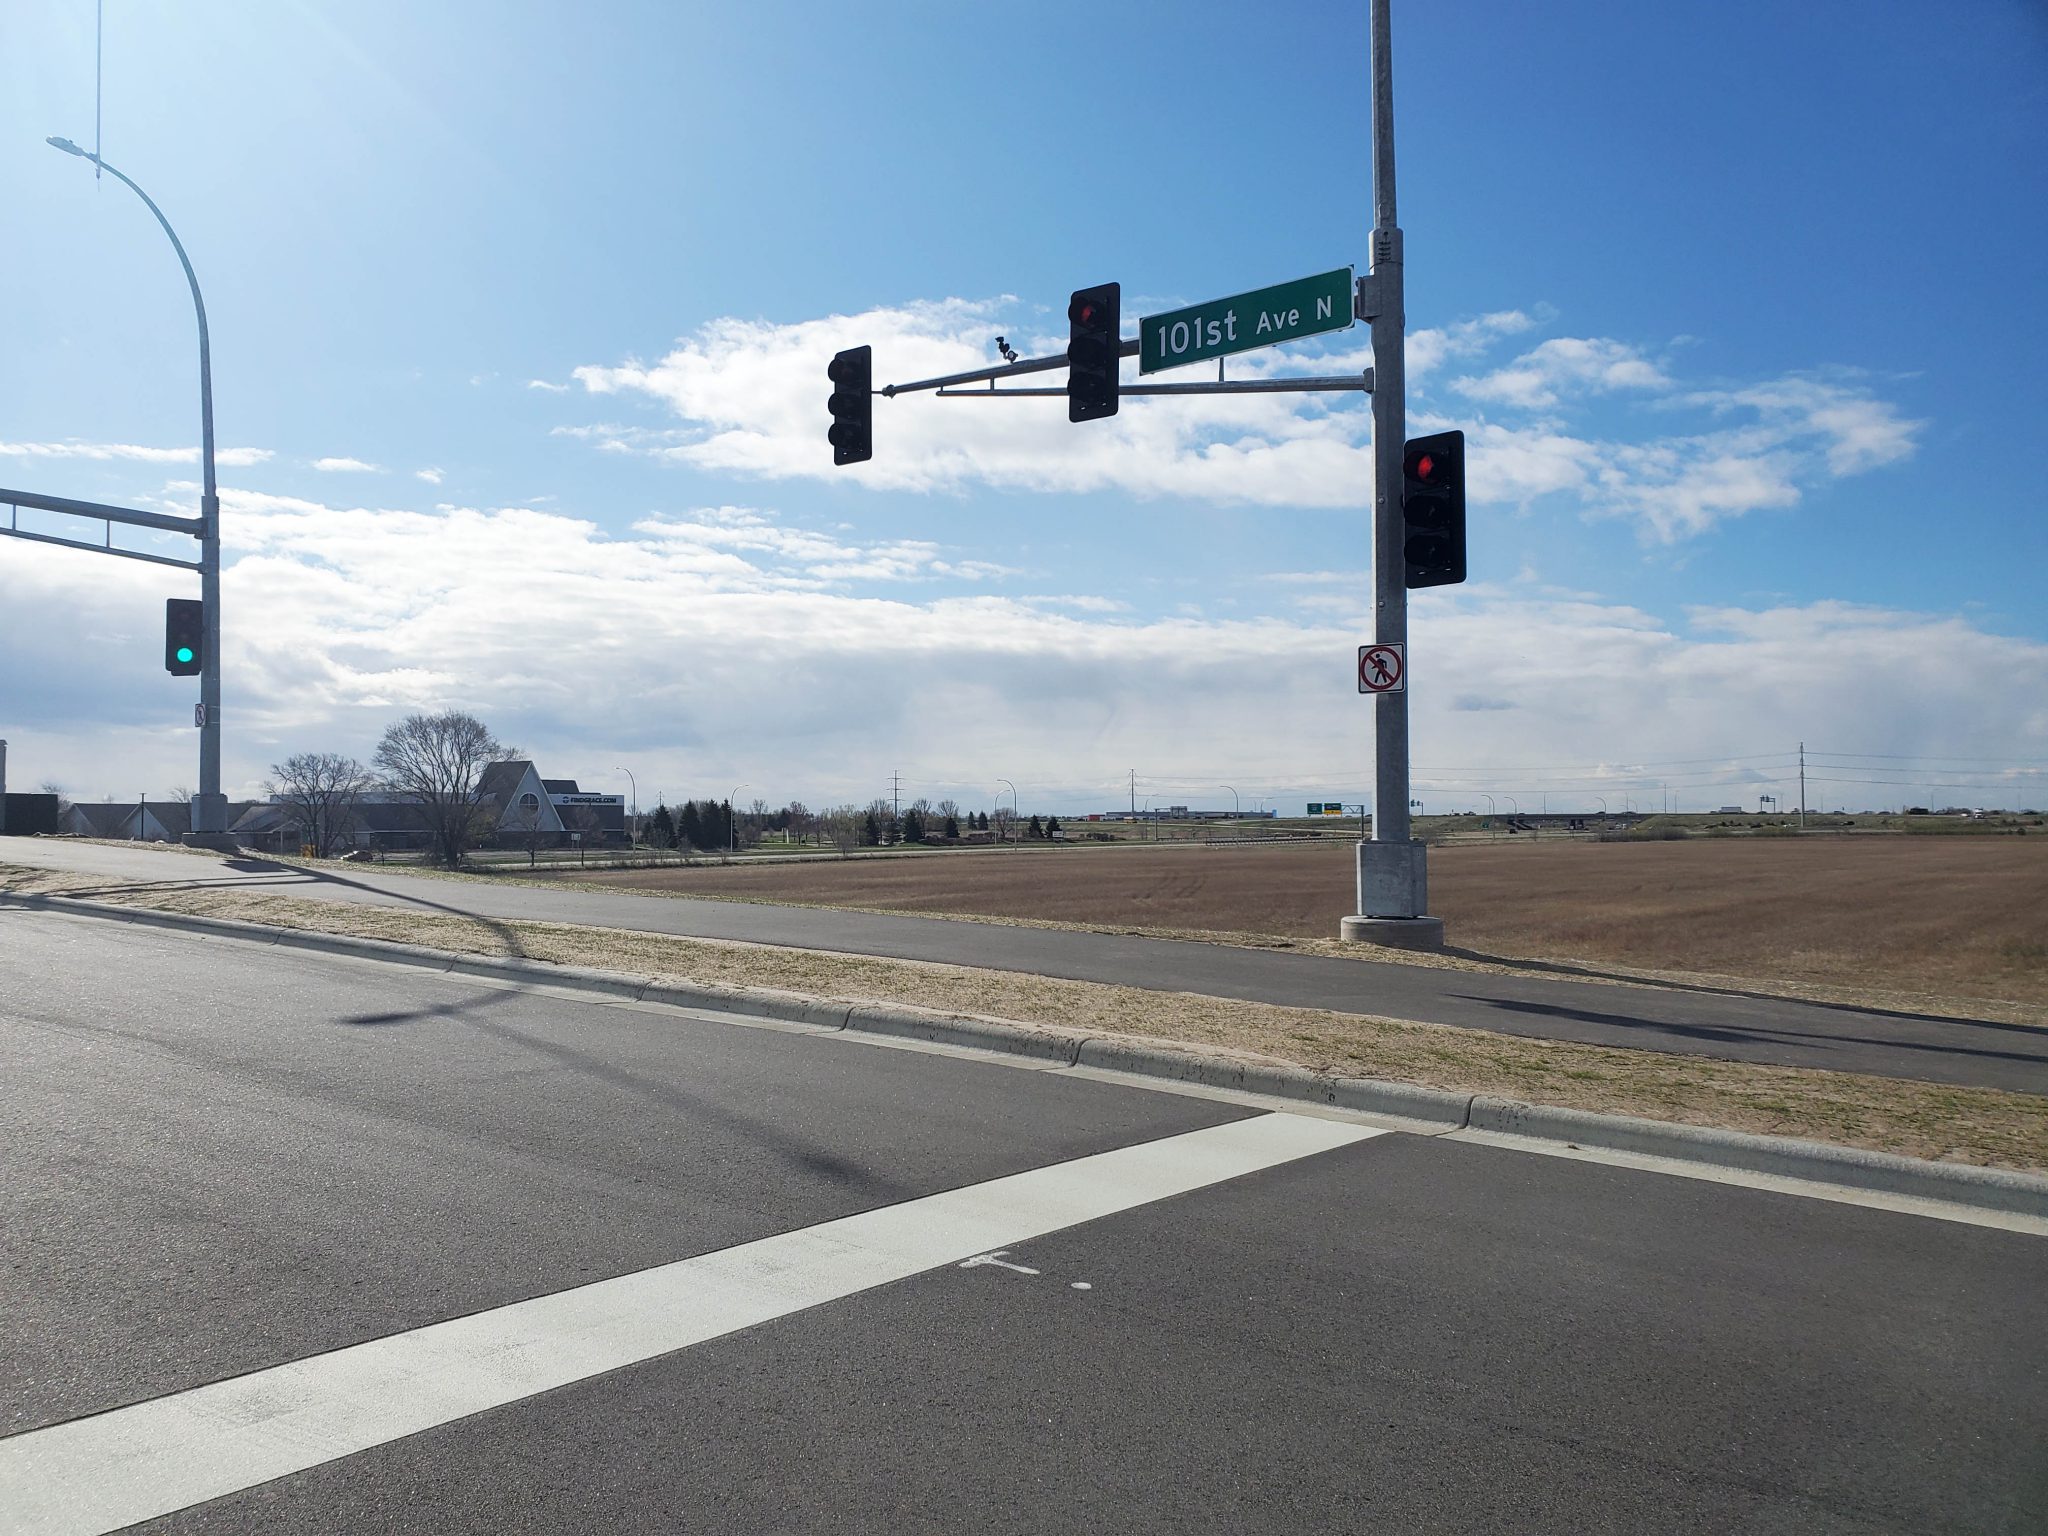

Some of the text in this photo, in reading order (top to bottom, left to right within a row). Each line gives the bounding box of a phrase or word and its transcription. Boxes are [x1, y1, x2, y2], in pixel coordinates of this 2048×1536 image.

[1158, 295, 1332, 357] 101st Ave N
